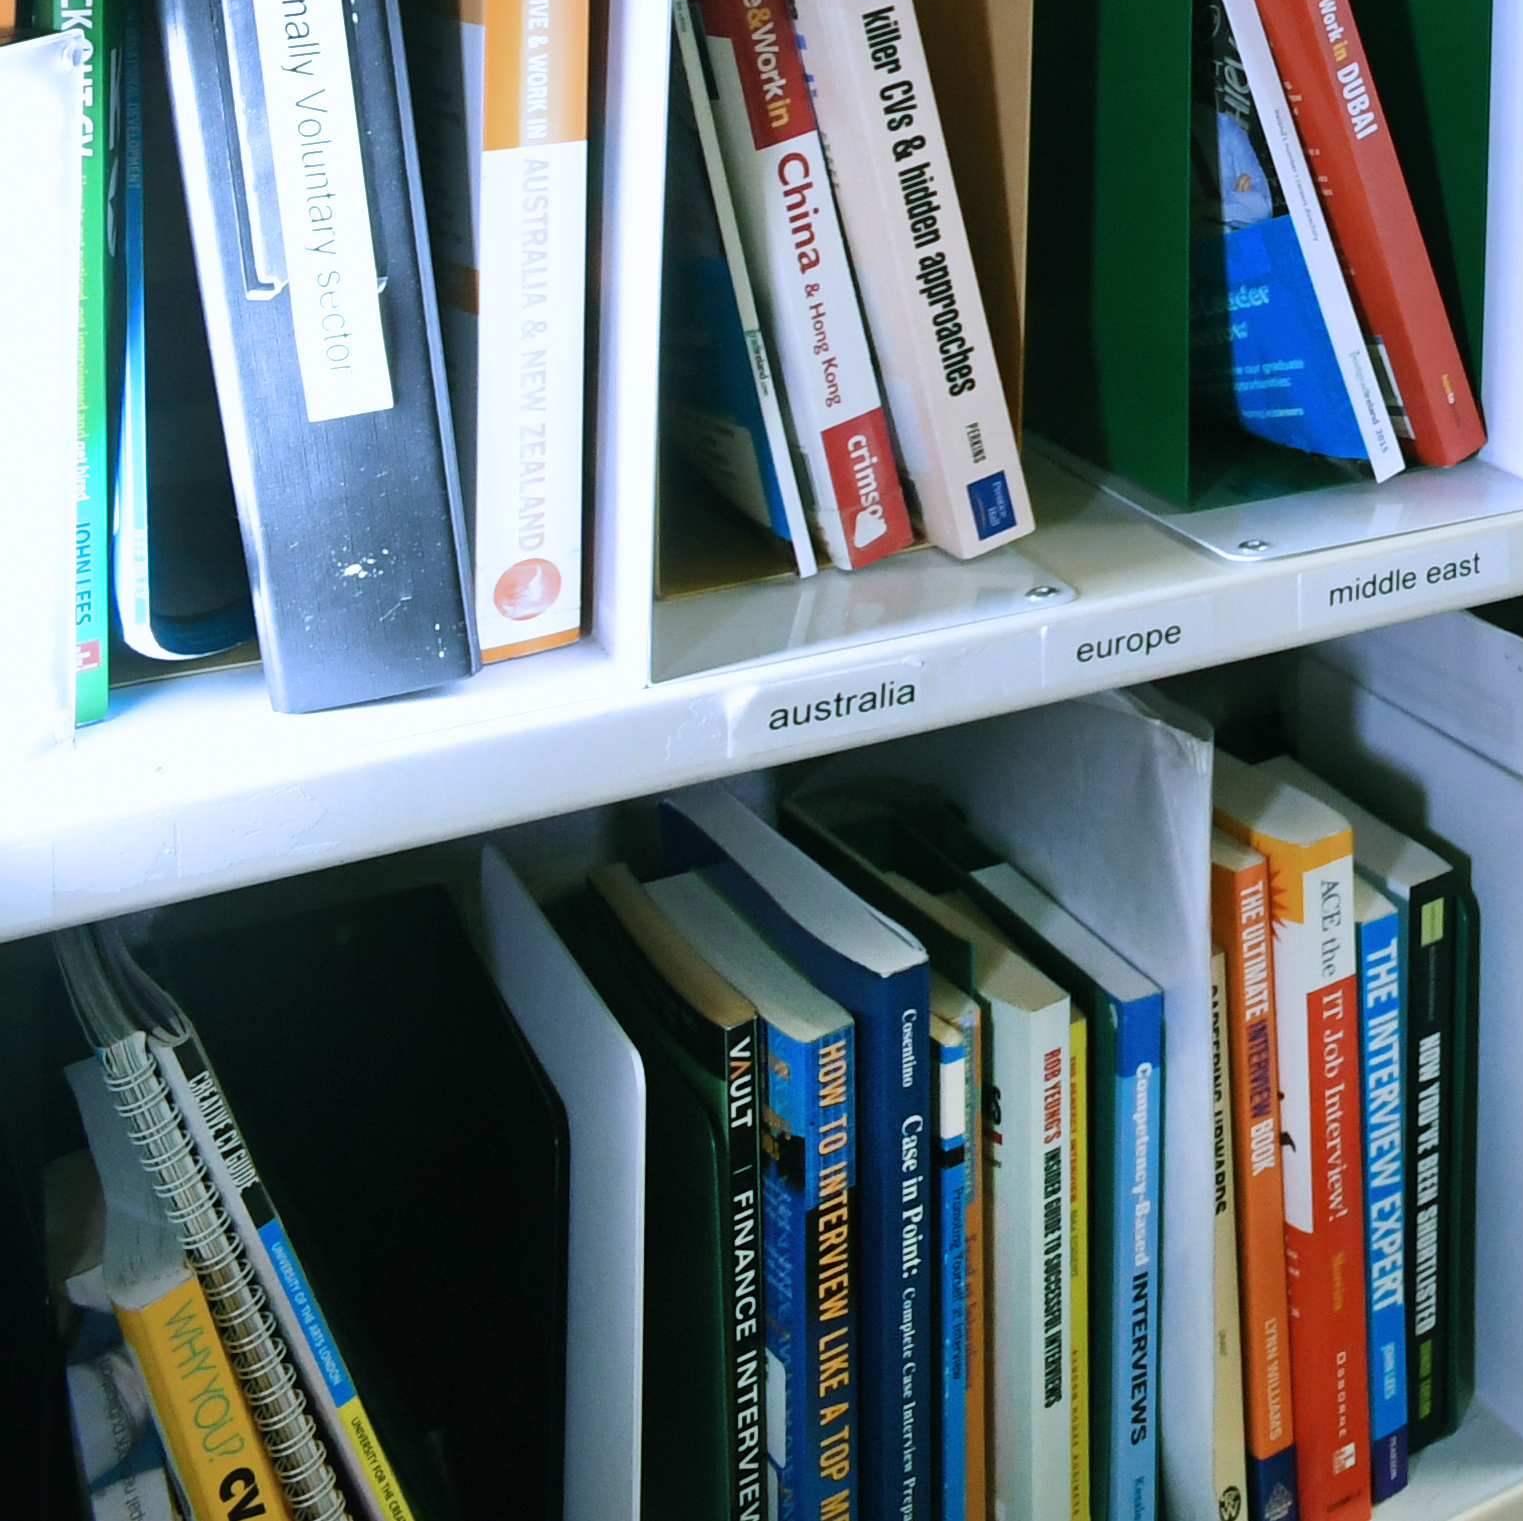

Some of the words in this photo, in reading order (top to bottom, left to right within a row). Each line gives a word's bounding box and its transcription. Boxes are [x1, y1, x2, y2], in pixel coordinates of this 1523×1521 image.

[1332, 39, 1348, 62] in
[1337, 61, 1378, 140] DUBAI
[295, 88, 336, 258] Voluntary
[317, 269, 353, 375] sector
[1329, 569, 1418, 608] middle
[1426, 553, 1481, 586] east
[1076, 623, 1182, 667] europe
[769, 680, 916, 732] australia
[1240, 880, 1264, 924] THE
[1321, 880, 1341, 932] ACE
[1242, 925, 1269, 1022] ULTIMATE
[1321, 937, 1340, 979] the
[1322, 989, 1343, 1020] IT
[818, 1040, 847, 1108] HOW
[902, 1008, 917, 1088] Cosentino
[1044, 1047, 1061, 1082] ROB
[1246, 1019, 1272, 1119] INTERVIEW
[1323, 1030, 1344, 1079] Job
[1418, 1032, 1441, 1082] NOW
[818, 1113, 848, 1157] TO
[1044, 1081, 1062, 1145] YEUNG'S
[1417, 1081, 1440, 1154] YOU'VE
[901, 1114, 924, 1173] Case
[1044, 1145, 1062, 1200] INSIDER
[1132, 1061, 1152, 1267] Competency-Based
[1251, 1118, 1275, 1177] BOOK
[1324, 1082, 1348, 1222] Interview!
[902, 1176, 924, 1203] in
[1416, 1152, 1439, 1208] BEEN
[818, 1160, 849, 1322] INTERVIEW
[902, 1204, 924, 1278] Point:
[1044, 1197, 1062, 1238] GUIDE
[1044, 1229, 1062, 1256] TO
[1044, 1250, 1062, 1334] SUCCESSFUL
[1415, 1203, 1438, 1337] SHORTLISTED
[899, 1287, 916, 1359] Complete
[1265, 1317, 1278, 1362] LYNN
[818, 1326, 849, 1398] LIKE
[902, 1361, 916, 1399] Case
[1044, 1329, 1062, 1409] INTERVIEWS
[1131, 1271, 1148, 1446] INTERVIEWS
[819, 1402, 849, 1427] A
[1266, 1363, 1283, 1441] WILLIAMS
[1336, 1351, 1347, 1438] OSBORNE
[819, 1425, 850, 1481] TOP
[902, 1401, 916, 1473] Interview
